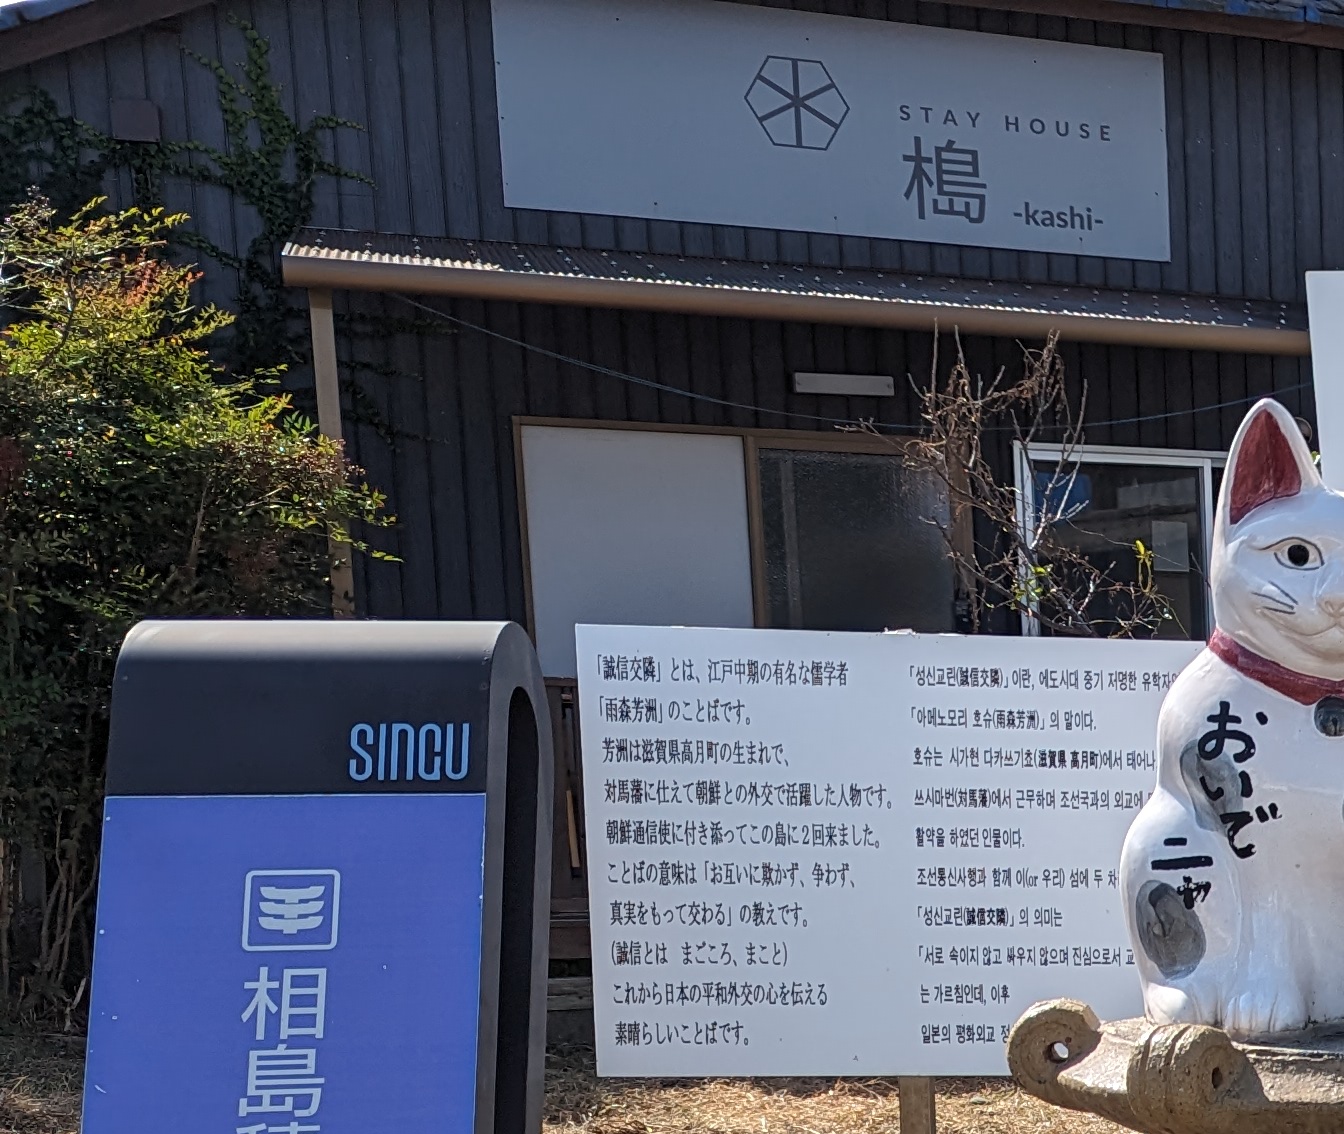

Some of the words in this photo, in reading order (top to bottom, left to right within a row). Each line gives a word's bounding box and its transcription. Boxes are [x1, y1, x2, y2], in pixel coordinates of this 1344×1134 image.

[899, 104, 981, 129] STAY
[1004, 114, 1112, 142] HOUSE
[1013, 201, 1104, 231] -kashi-
[1039, 668, 1079, 690] 에도시대
[1084, 669, 1104, 690] 중기
[1108, 670, 1137, 691] 저명한
[599, 695, 752, 725] 「雨森芳洲」のことばです。
[911, 706, 968, 729] 「아메노모리
[1064, 709, 1097, 732] 말이다.
[349, 722, 470, 781] SINGU
[602, 737, 790, 767] 芳洲は滋賀県高月町の生まれで、
[913, 746, 943, 767] 호슈는
[949, 746, 980, 768] 시가현
[1197, 700, 1282, 859] おいで
[604, 778, 892, 809] 対馬藩に仕えて朝鮮との外交で活躍した人物です。
[1016, 788, 1056, 809] 근무하며
[1060, 789, 1110, 810] 조선국과의
[1114, 789, 1144, 810] 외교에
[915, 826, 945, 848] 활약을
[949, 826, 979, 848] 하였던
[982, 827, 1025, 849] 인물이다.
[607, 860, 855, 888] ことばの意味は「お互いに欺かず、争わず、
[917, 866, 987, 888] 조선통신사행과
[992, 867, 1013, 888] 함께
[1041, 868, 1065, 889] 우리)
[1069, 868, 1089, 889] 섬에
[1093, 869, 1104, 889] 두
[1107, 869, 1120, 889] 차
[610, 900, 808, 928] 真実をもって交わる」の教えです。
[1033, 907, 1063, 927] 의미는
[918, 945, 945, 966] 「서로
[949, 946, 979, 967] 속이지
[982, 946, 1002, 967] 않고
[1039, 946, 1069, 967] 않으며
[1072, 946, 1121, 967] 진심으로서
[613, 981, 828, 1007] これから日本の平和外交の心を伝える
[920, 984, 931, 1004] 는
[934, 984, 987, 1007] 가르침인데,
[991, 984, 1010, 1004] 이후
[614, 1020, 749, 1047] 素晴らしいことばです。
[921, 1023, 951, 1044] 일본의
[955, 1024, 996, 1044] 평화외교
